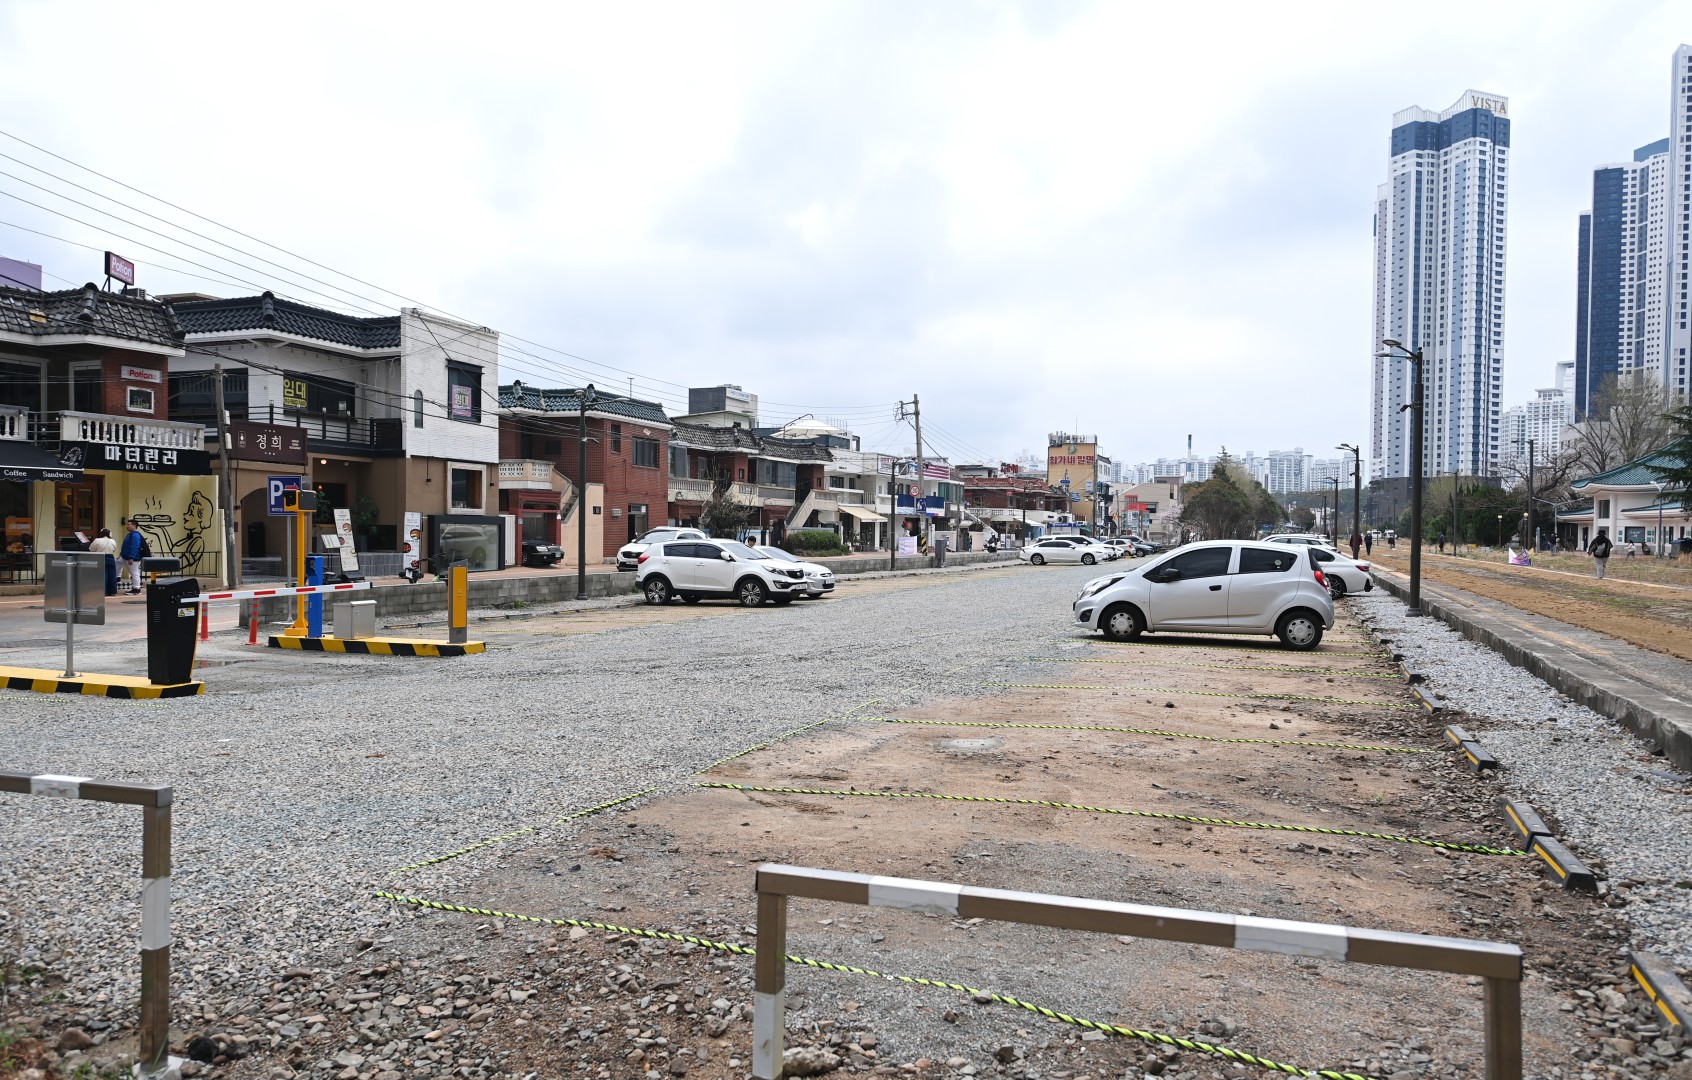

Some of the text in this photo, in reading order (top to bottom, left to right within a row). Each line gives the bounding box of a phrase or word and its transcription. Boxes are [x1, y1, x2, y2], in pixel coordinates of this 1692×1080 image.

[1471, 95, 1507, 114] VISTA
[111, 256, 133, 278] Potion
[129, 369, 153, 379] Potion
[283, 379, 306, 399] 임대
[256, 434, 282, 451] 정희
[104, 445, 178, 466] 마더린러
[1050, 455, 1076, 465] 최가네
[3, 469, 74, 479] Coffee Sandwich
[126, 463, 156, 471] BAGEL
[270, 480, 284, 506] P
